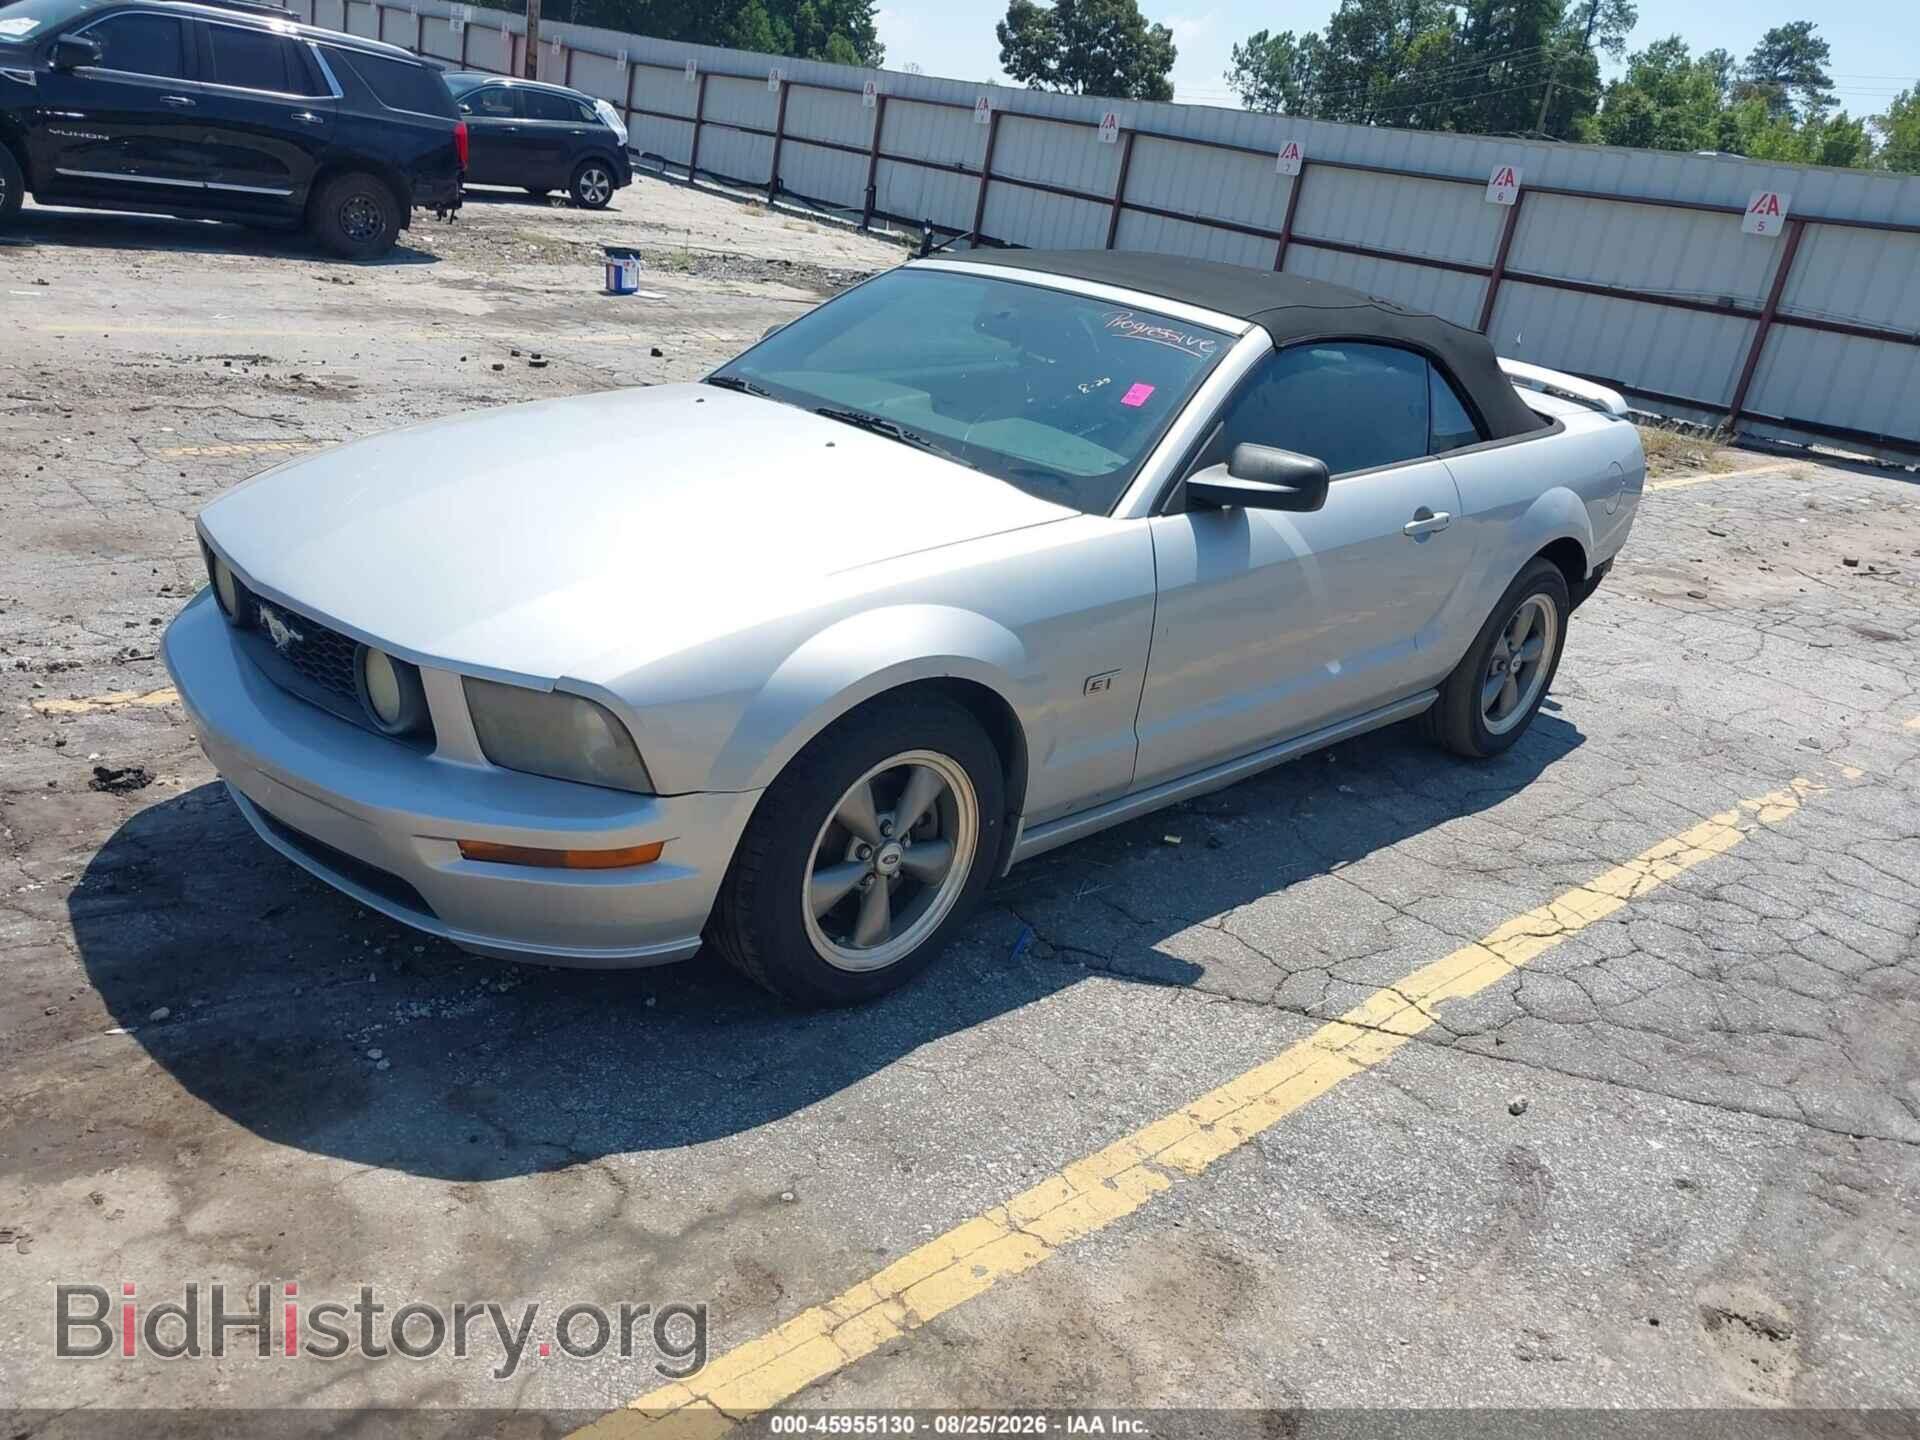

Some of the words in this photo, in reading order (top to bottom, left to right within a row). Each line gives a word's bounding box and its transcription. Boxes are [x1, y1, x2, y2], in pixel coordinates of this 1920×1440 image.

[1496, 191, 1504, 201] 6
[1757, 221, 1765, 232] 5
[1102, 310, 1217, 354] Progressive
